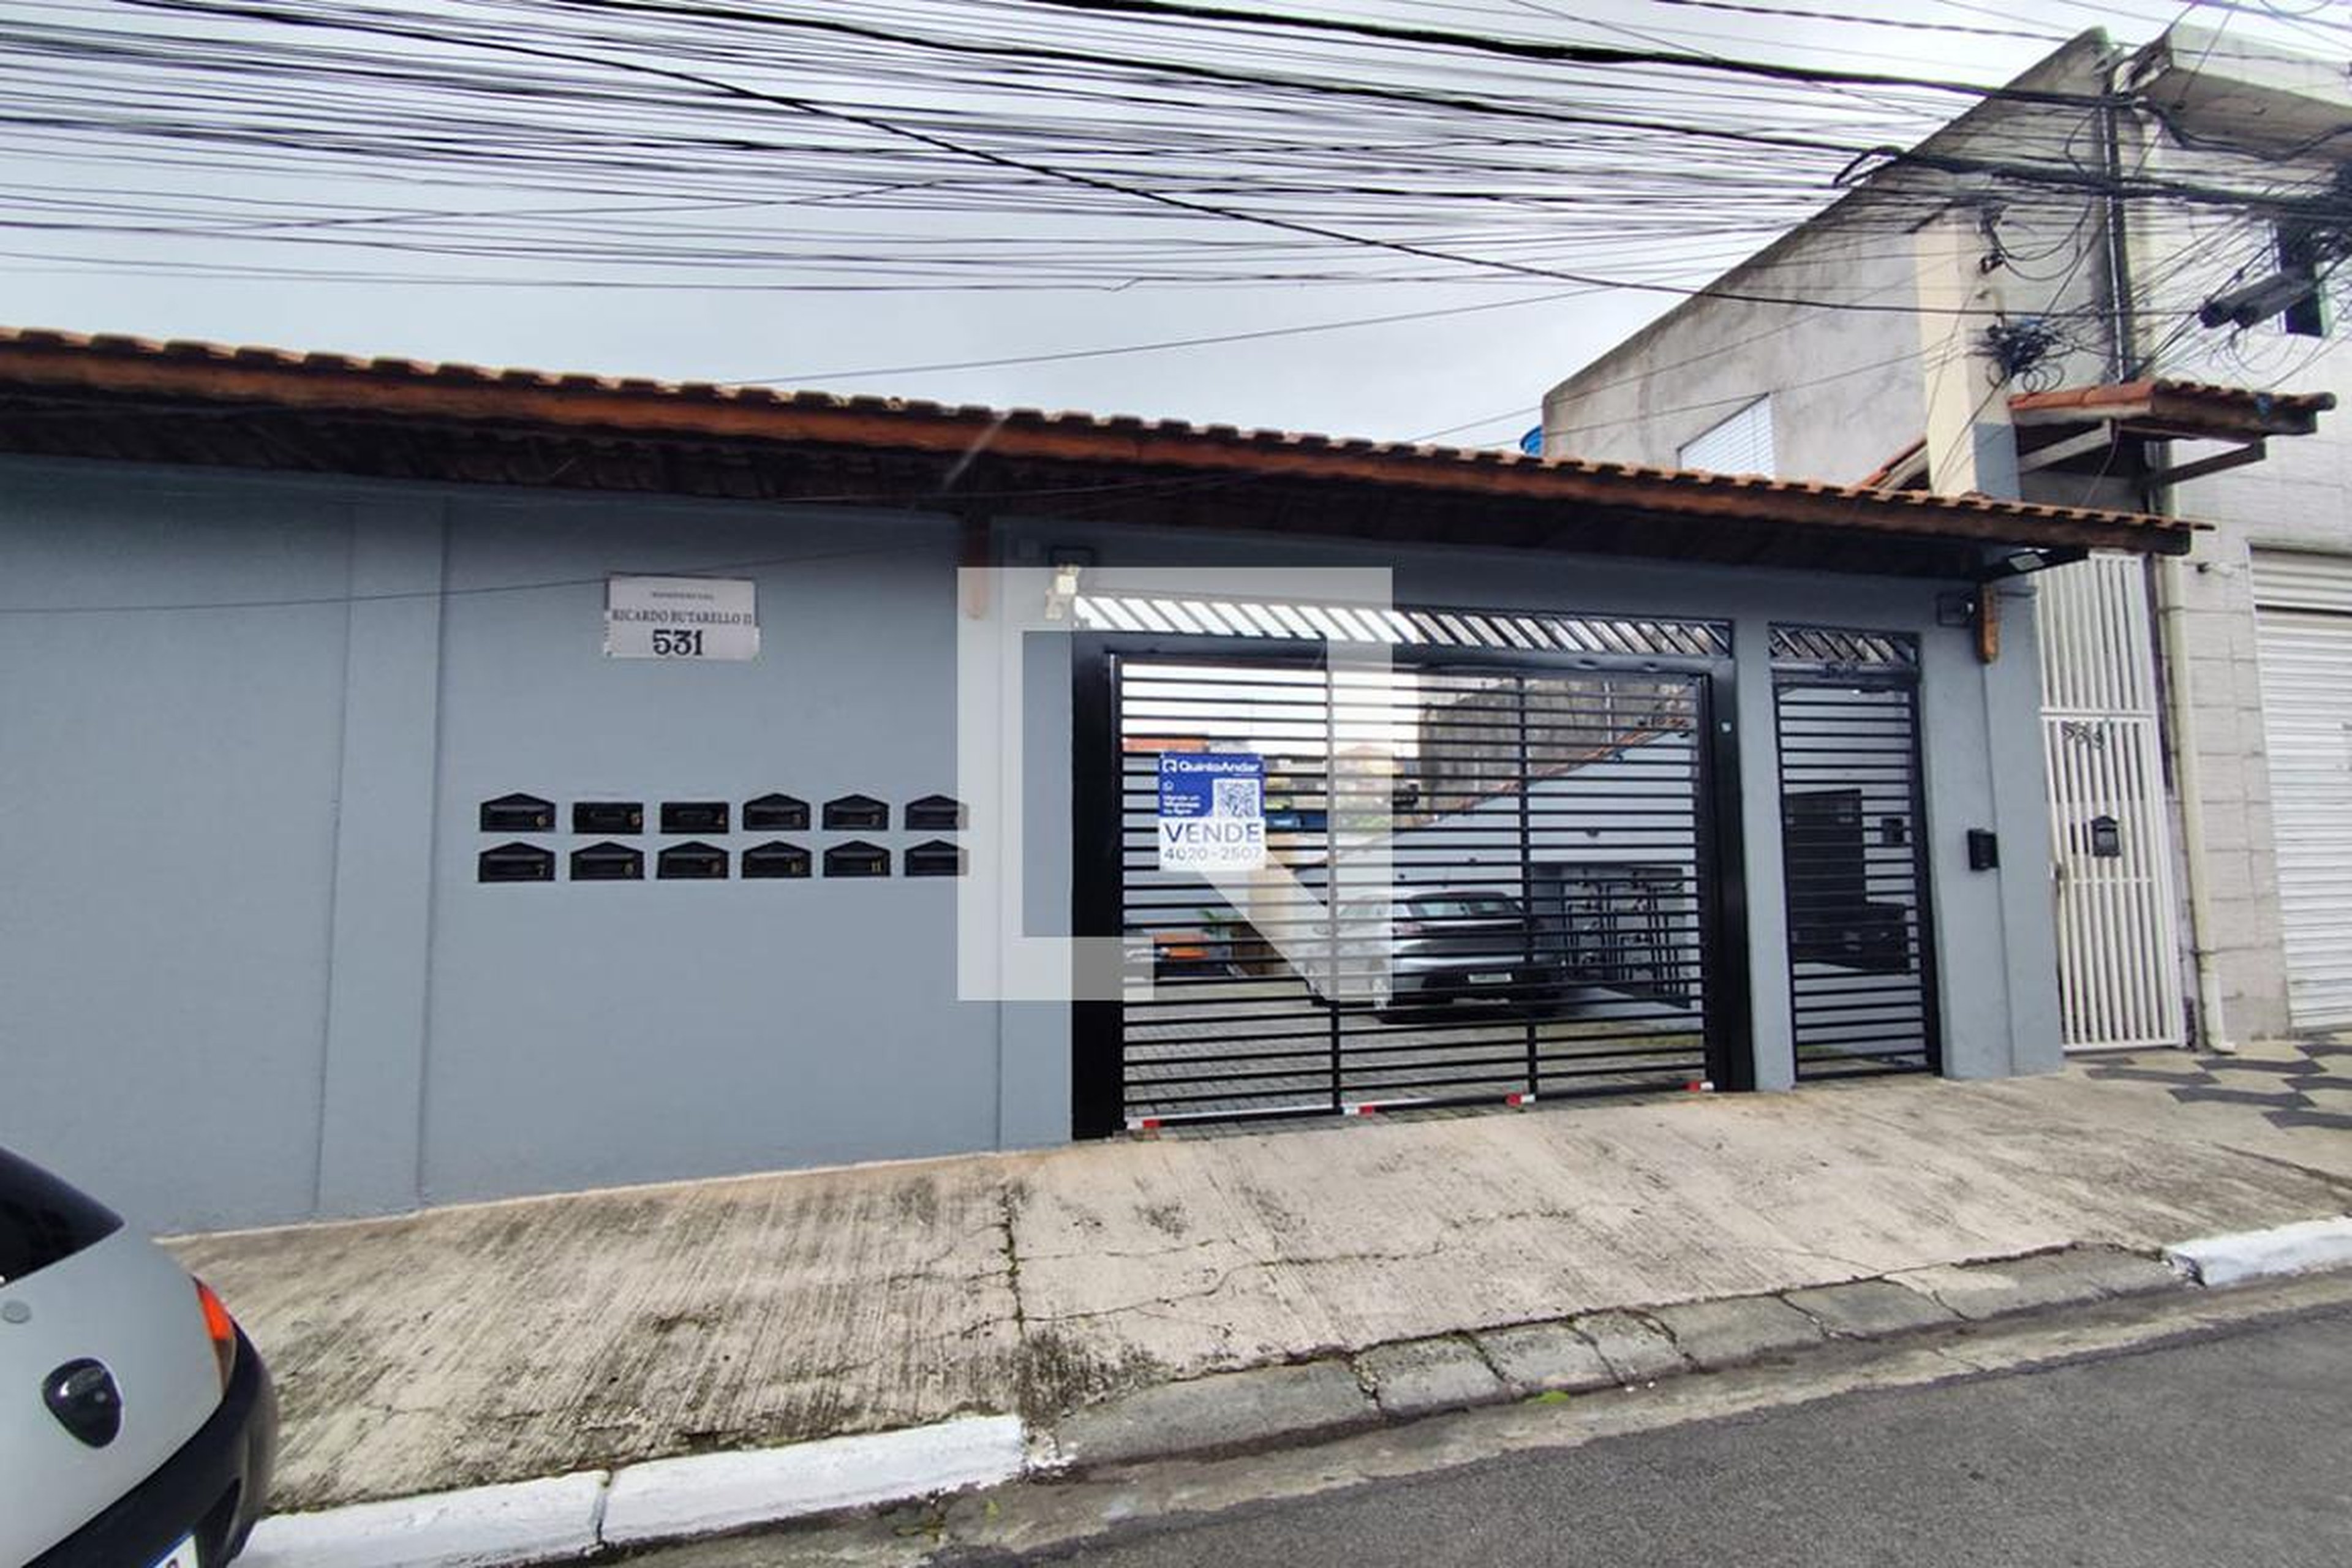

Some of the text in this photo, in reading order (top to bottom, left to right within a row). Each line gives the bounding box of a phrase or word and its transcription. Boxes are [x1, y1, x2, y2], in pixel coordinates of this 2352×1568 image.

[612, 609, 669, 623] RICARDO
[653, 629, 703, 656] 531
[1179, 760, 1260, 773] QuintoAndar
[1164, 823, 1261, 843] VENDE
